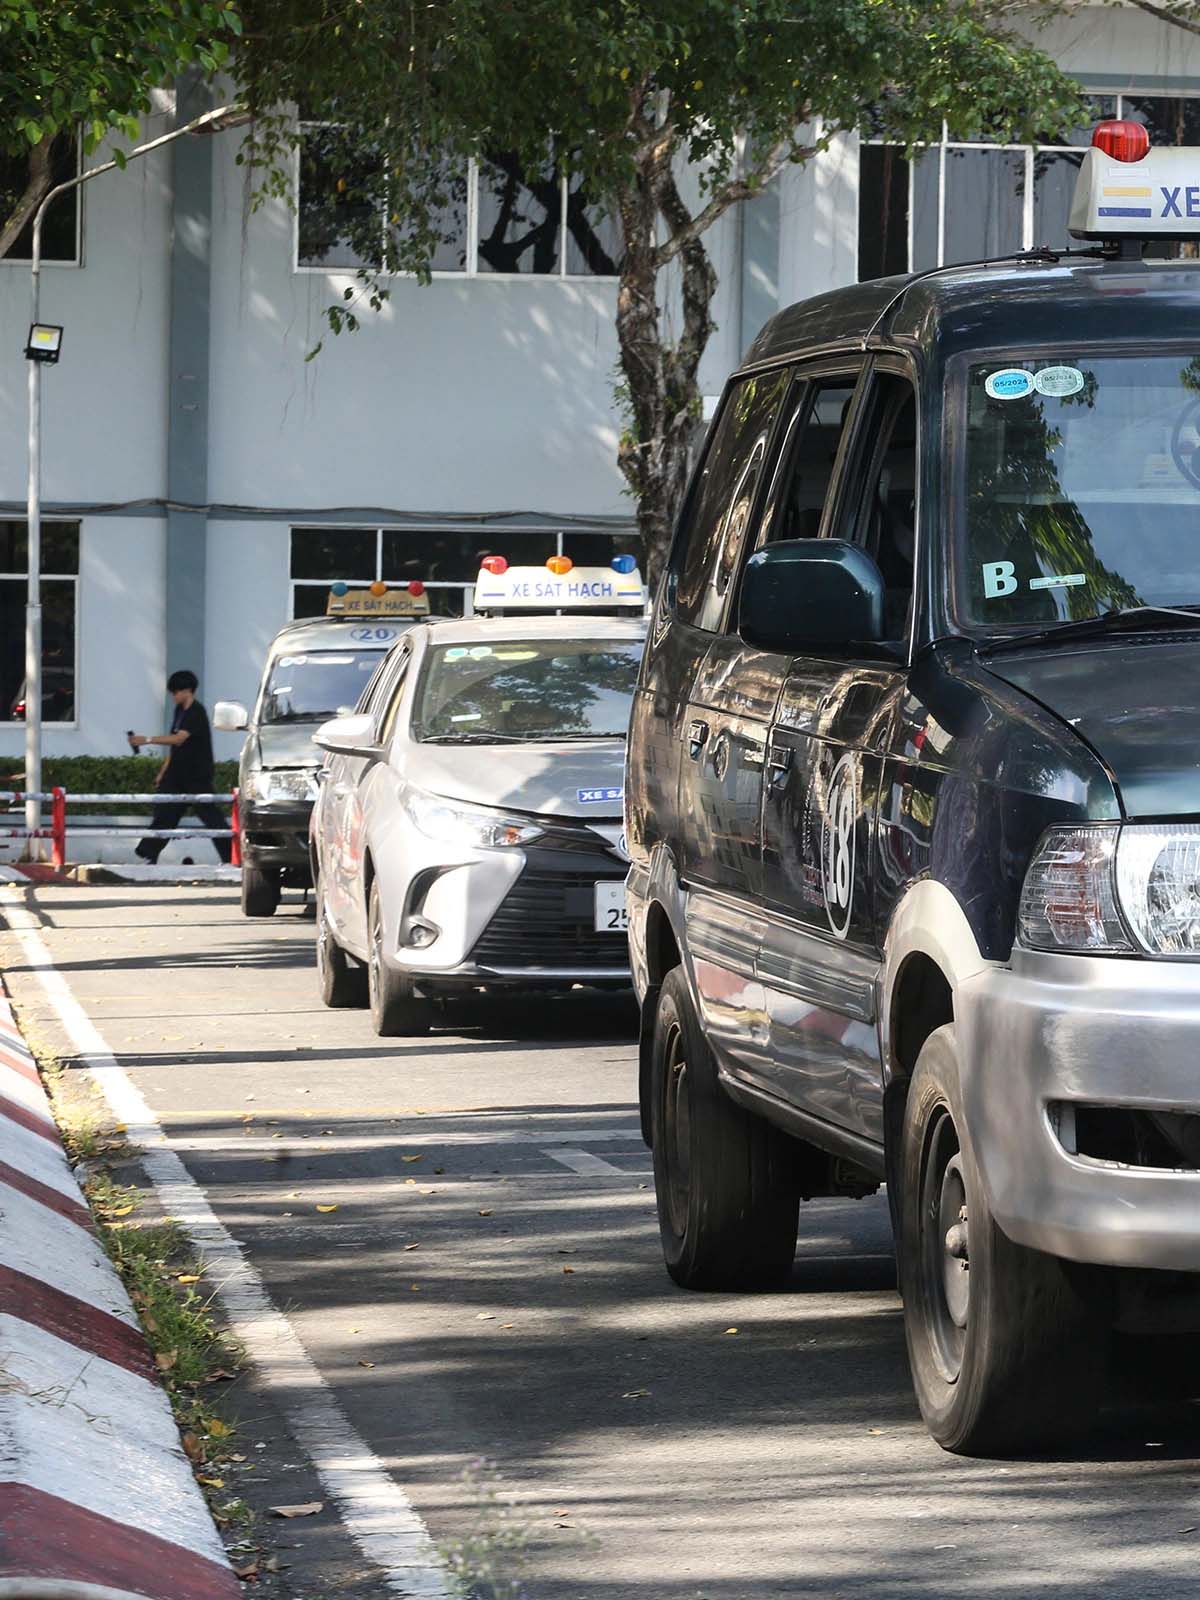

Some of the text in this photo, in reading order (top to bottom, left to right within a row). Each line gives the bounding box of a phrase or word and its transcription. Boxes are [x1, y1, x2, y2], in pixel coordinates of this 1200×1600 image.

[1159, 187, 1200, 218] XE
[994, 377, 1028, 388] 05/2024
[982, 560, 1018, 599] B
[512, 583, 530, 597] XE
[360, 628, 390, 640] 20
[581, 790, 603, 801] XE
[827, 785, 853, 909] 18
